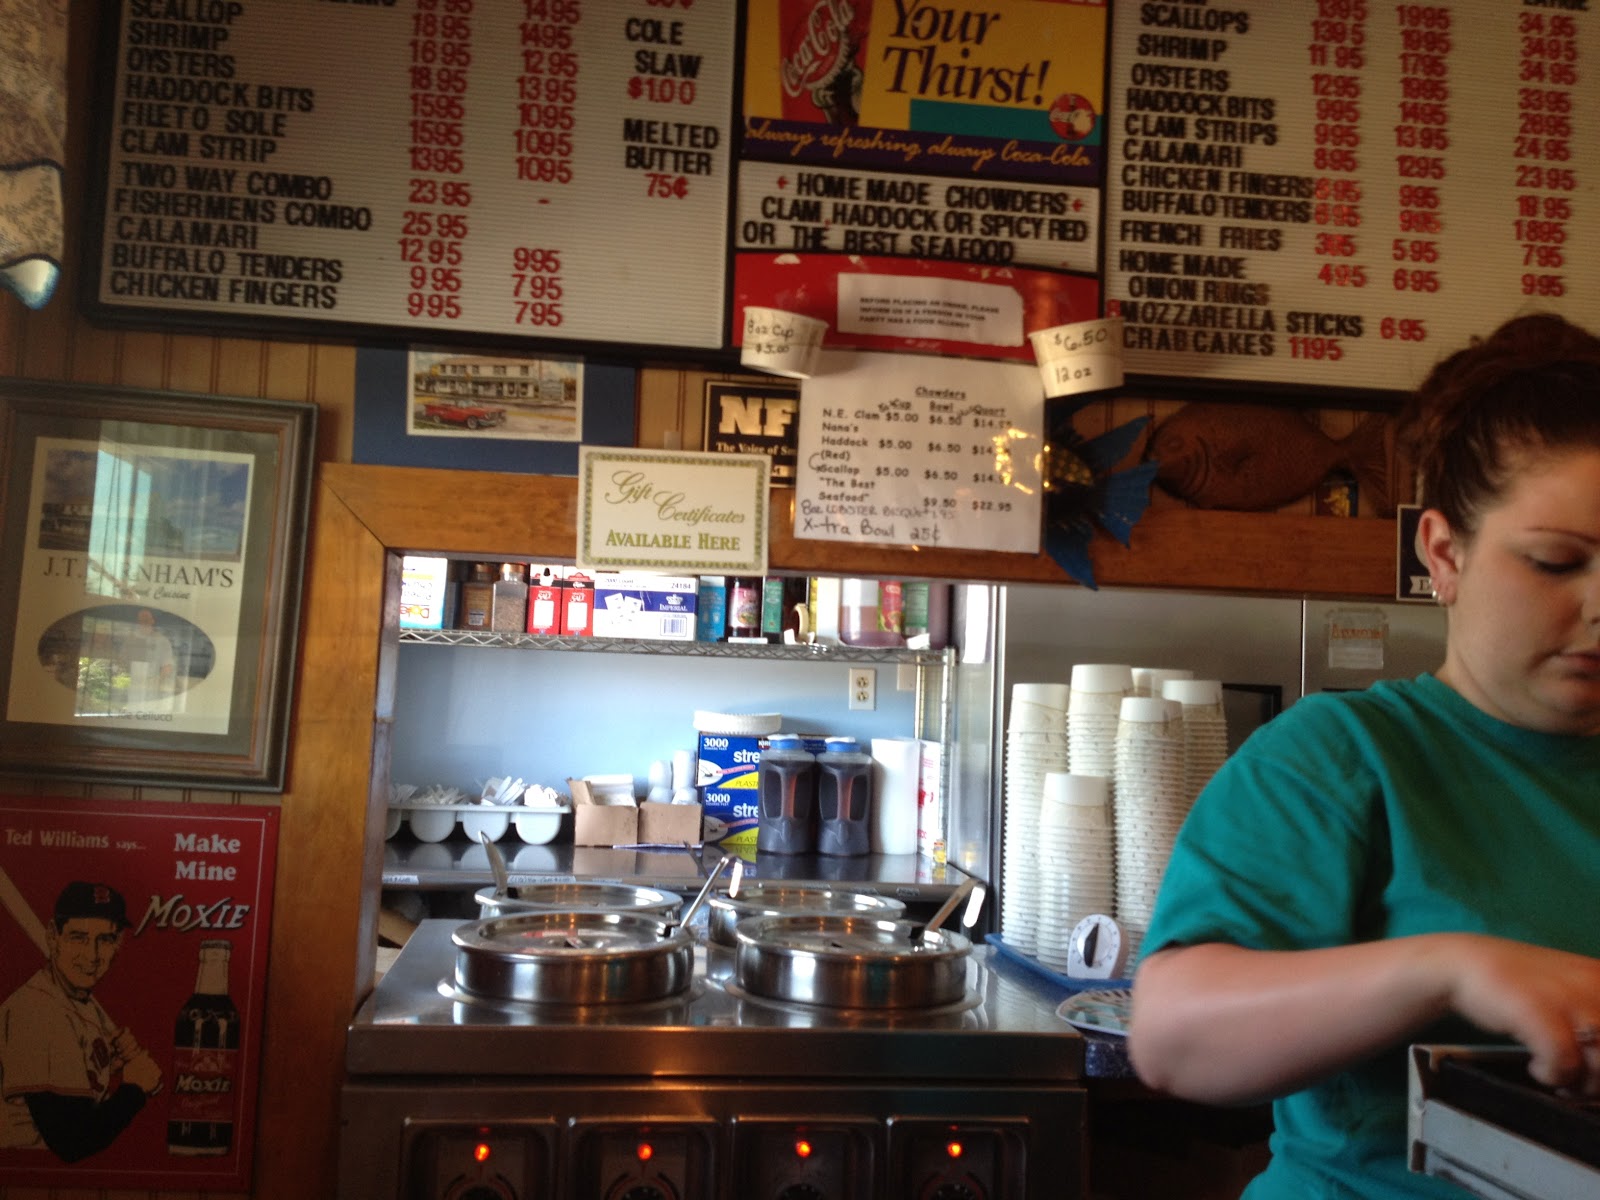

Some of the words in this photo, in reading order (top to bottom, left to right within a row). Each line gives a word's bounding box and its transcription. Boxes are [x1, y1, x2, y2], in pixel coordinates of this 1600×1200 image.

[625, 17, 684, 46] COLE
[889, 0, 1001, 45] Your
[1139, 3, 1249, 35] SCALLOPS
[128, 20, 229, 51] SHRIMP
[1136, 33, 1228, 62] SHRIMP
[125, 46, 235, 79] OYSTERS
[634, 50, 704, 79] SLAW
[883, 45, 1052, 106] Thirst!
[1131, 63, 1231, 93] OYSTERS
[123, 74, 250, 107] HADDOCK
[256, 85, 314, 113] BITS
[1126, 87, 1222, 117] HADDOCK
[1227, 96, 1276, 122] BITS
[225, 109, 288, 138] SOLE
[623, 118, 719, 149] MELTED
[1124, 113, 1187, 139] CLAM
[1194, 117, 1279, 147] STRIPS
[119, 128, 189, 157] CLAM
[199, 134, 277, 164] STRIP
[624, 146, 713, 176] BUTTER
[821, 127, 922, 162] refreshing
[927, 135, 996, 171] always
[1122, 138, 1244, 168] CALAMARI
[121, 161, 177, 189] TWO
[185, 165, 237, 194] WAY
[247, 170, 333, 201] COMBO
[645, 173, 688, 199] 75¢
[797, 172, 861, 200] HOME
[865, 178, 931, 206] MADE
[945, 186, 1069, 215] CHOWDERS
[1121, 164, 1221, 192] CHICKEN
[1227, 171, 1315, 200] FINGERS
[113, 188, 277, 224] FISHERMENS
[284, 201, 373, 232] COMBO
[761, 196, 821, 223] CLAM
[832, 202, 938, 232] HADDOCK
[944, 210, 973, 235] OR
[980, 213, 1040, 240] SPICY
[1048, 218, 1087, 243] RED
[1121, 190, 1216, 217] BUFFALO
[1220, 196, 1312, 224] TENDERS
[116, 215, 259, 250] CALAMARI
[742, 221, 776, 245] OR
[791, 225, 828, 252] THE
[843, 230, 900, 256] BEST
[910, 235, 1014, 263] SEAFOOD
[1120, 219, 1203, 247] FRENCH
[1219, 225, 1283, 252] FRIES
[111, 243, 226, 275] BUFFALO
[237, 252, 343, 284] TENDERS
[1119, 249, 1180, 276] HOME
[1183, 254, 1247, 280] MADE
[109, 270, 219, 302] CHICKEN
[229, 279, 338, 310] FINGERS
[772, 324, 794, 341] Cup
[1120, 299, 1276, 333] MOZZARELLA
[1285, 311, 1364, 339] STICKS
[1122, 325, 1189, 352] CRAB
[1192, 330, 1276, 357] CAKES
[822, 422, 859, 433] Nana's
[854, 410, 880, 420] Clam
[820, 449, 851, 462] (Red)
[821, 436, 868, 447] Haddock
[604, 470, 653, 505] Gift
[850, 478, 876, 490] Best
[653, 491, 746, 527] Certificates
[605, 529, 692, 550] AVAILABLE
[697, 531, 741, 552] HERE
[860, 518, 895, 539] Bowl
[671, 582, 692, 591] 24184
[659, 603, 688, 612] IMPERIAL
[704, 738, 729, 749] 3000
[733, 749, 760, 764] stre
[705, 792, 731, 803] 3000
[5, 828, 33, 846] Ted
[40, 830, 110, 848] Williams
[174, 832, 242, 854] Make
[175, 860, 238, 881] Mine
[133, 894, 251, 937] MOXIE
